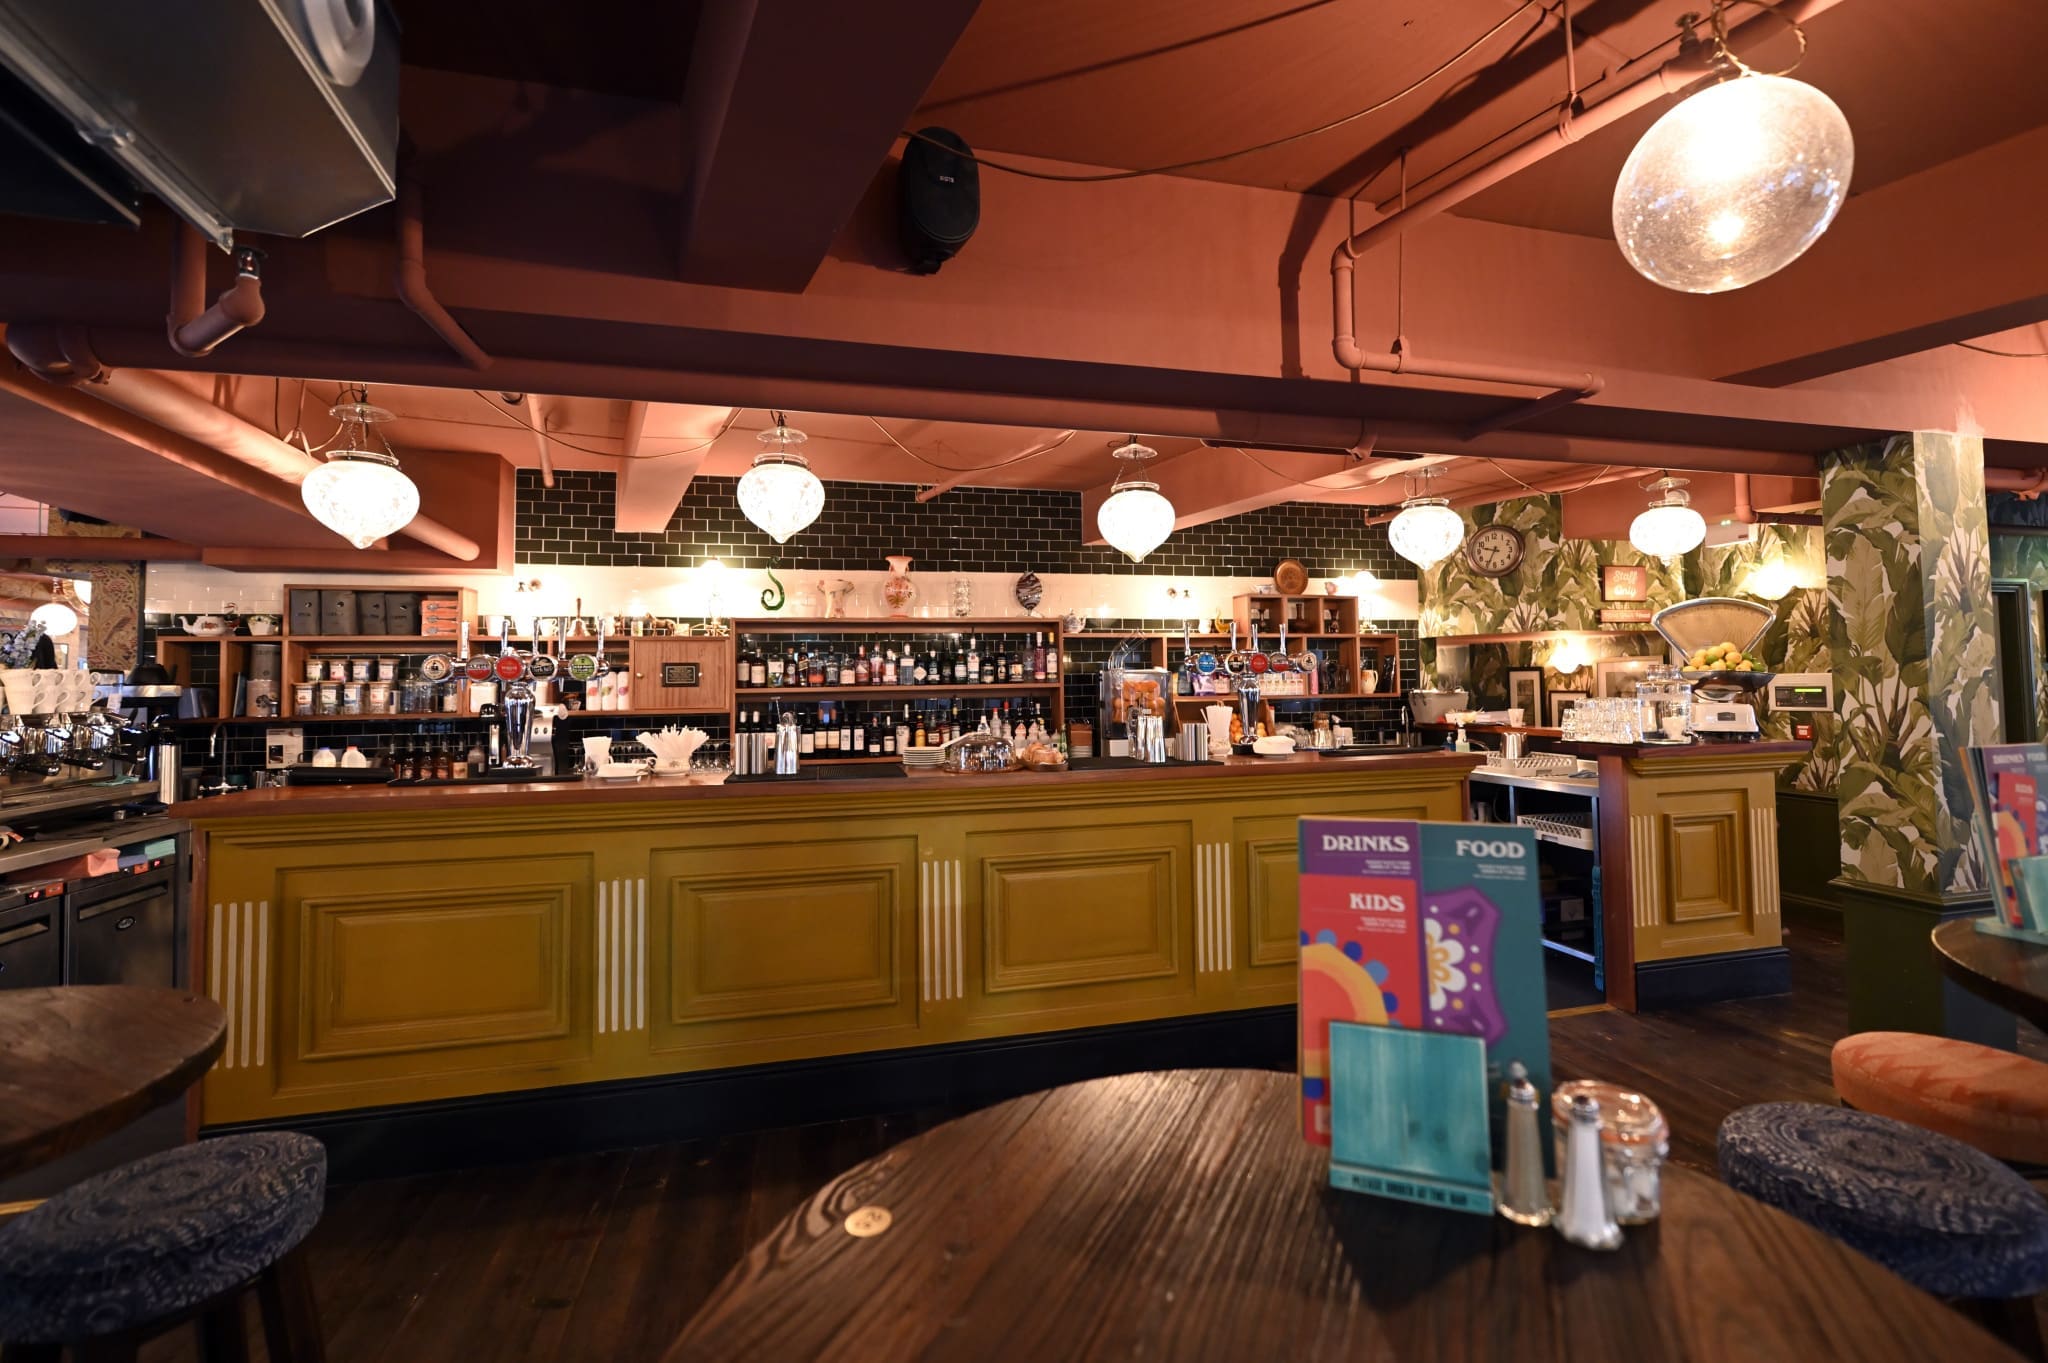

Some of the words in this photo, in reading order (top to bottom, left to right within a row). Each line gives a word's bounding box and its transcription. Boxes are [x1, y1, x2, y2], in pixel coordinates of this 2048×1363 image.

[1613, 570, 1638, 585] Staff
[1614, 584, 1637, 598] Only
[1322, 835, 1410, 853] DRINKS
[1455, 839, 1526, 858] FOOD
[1349, 893, 1405, 913] KIDS
